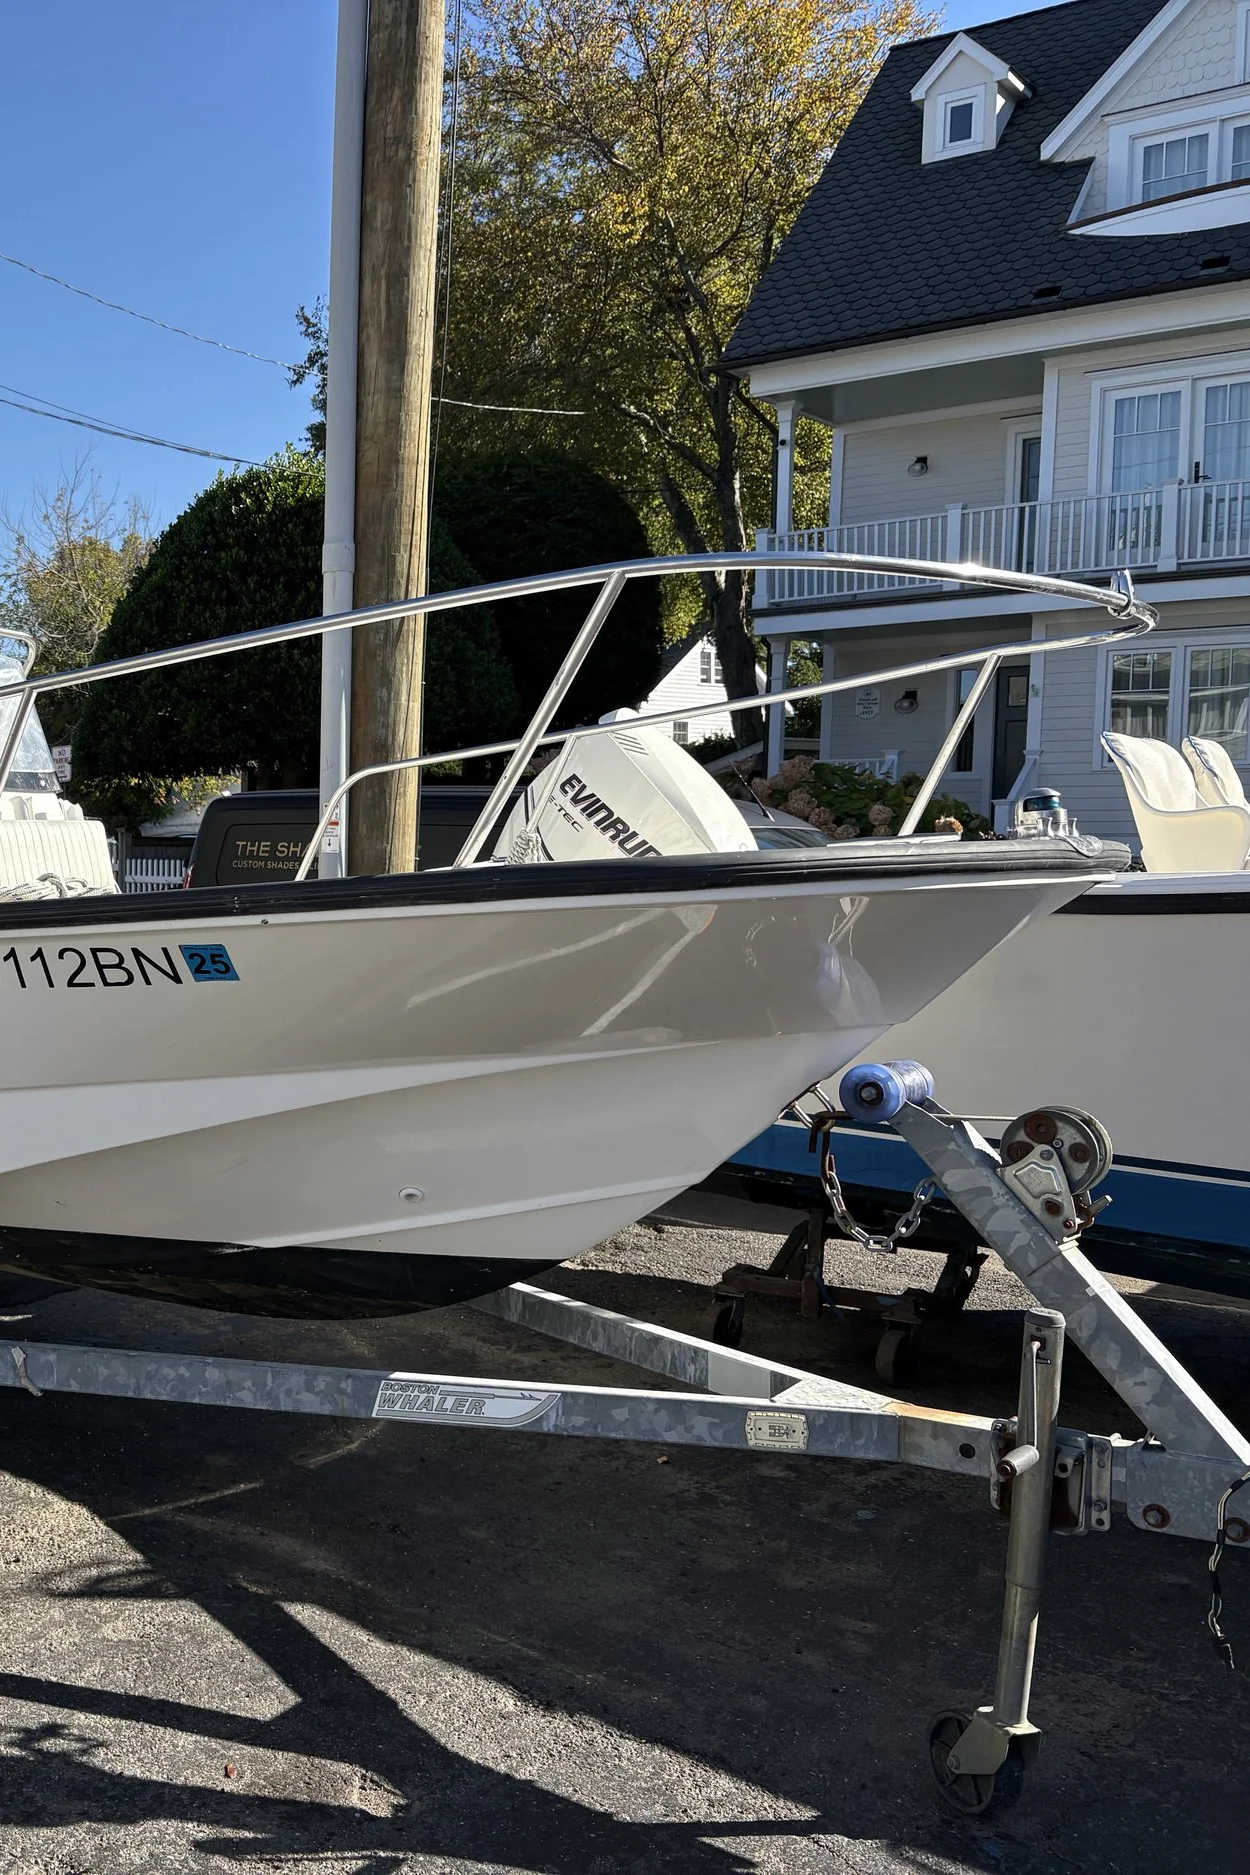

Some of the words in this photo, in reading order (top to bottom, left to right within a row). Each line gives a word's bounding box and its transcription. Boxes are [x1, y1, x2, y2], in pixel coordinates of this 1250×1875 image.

[236, 841, 271, 856] THE
[232, 860, 265, 868] CUSTOM
[267, 861, 299, 870] SHADES
[188, 952, 231, 975] 25
[381, 1382, 440, 1395] BOSTON
